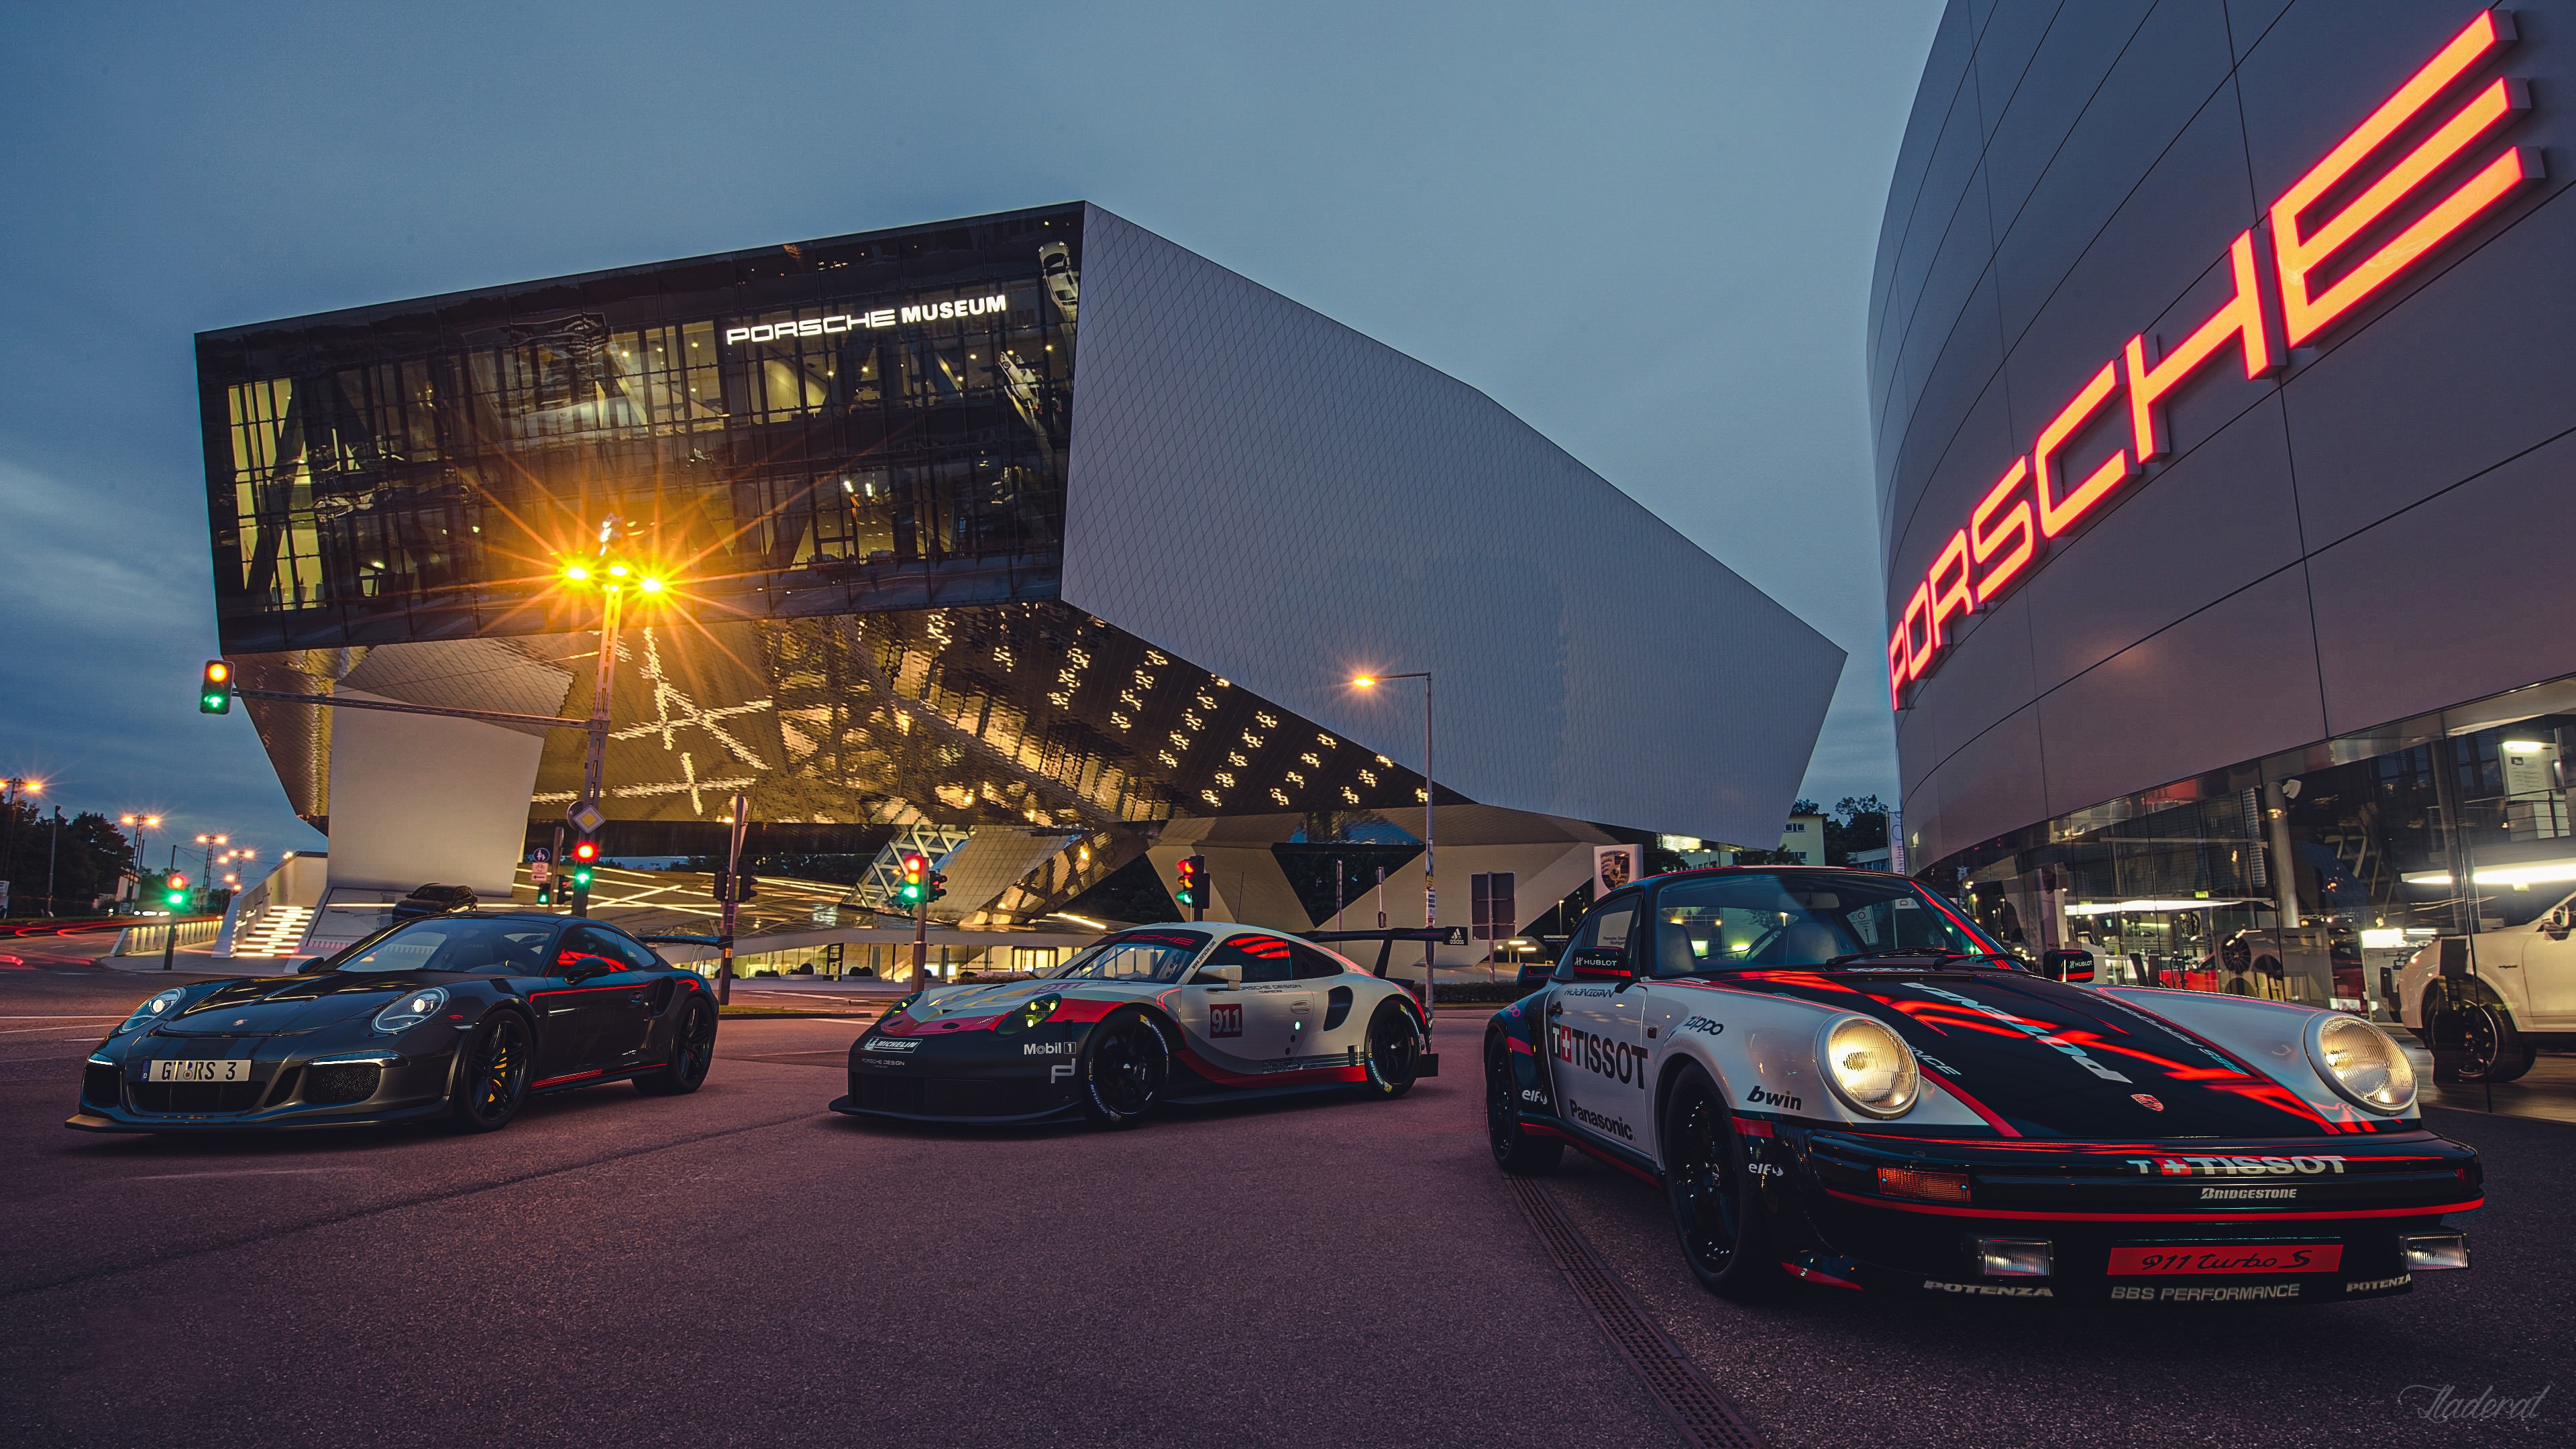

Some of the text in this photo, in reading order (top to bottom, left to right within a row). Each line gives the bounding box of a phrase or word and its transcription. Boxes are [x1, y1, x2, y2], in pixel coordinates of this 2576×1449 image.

[727, 295, 1007, 345] PORSCHE MUSEUM
[1888, 8, 2525, 711] PORSCHE
[2075, 959, 2092, 967] HUBLOT
[1212, 1009, 1241, 1033] 911
[1684, 1015, 1724, 1036] zippo
[1024, 1042, 1062, 1055] Mobil
[1572, 1028, 1648, 1090] TISSOT
[225, 1061, 237, 1080] 3
[1090, 1084, 1108, 1114] MICHELIN
[1521, 1089, 1541, 1102] elf
[1746, 1085, 1802, 1111] bwin
[1569, 1099, 1633, 1140] Panasonic
[1748, 1163, 1772, 1174] elf
[2183, 1156, 2347, 1175] TISSOT
[2200, 1188, 2298, 1199] BRIDGESTONE
[2141, 1254, 2192, 1271] 911
[2277, 1250, 2313, 1269] S
[1923, 1280, 2053, 1297] POTENZA
[2111, 1283, 2301, 1301] BBS PERFORMANCE
[2346, 1273, 2412, 1292] POTENZA
